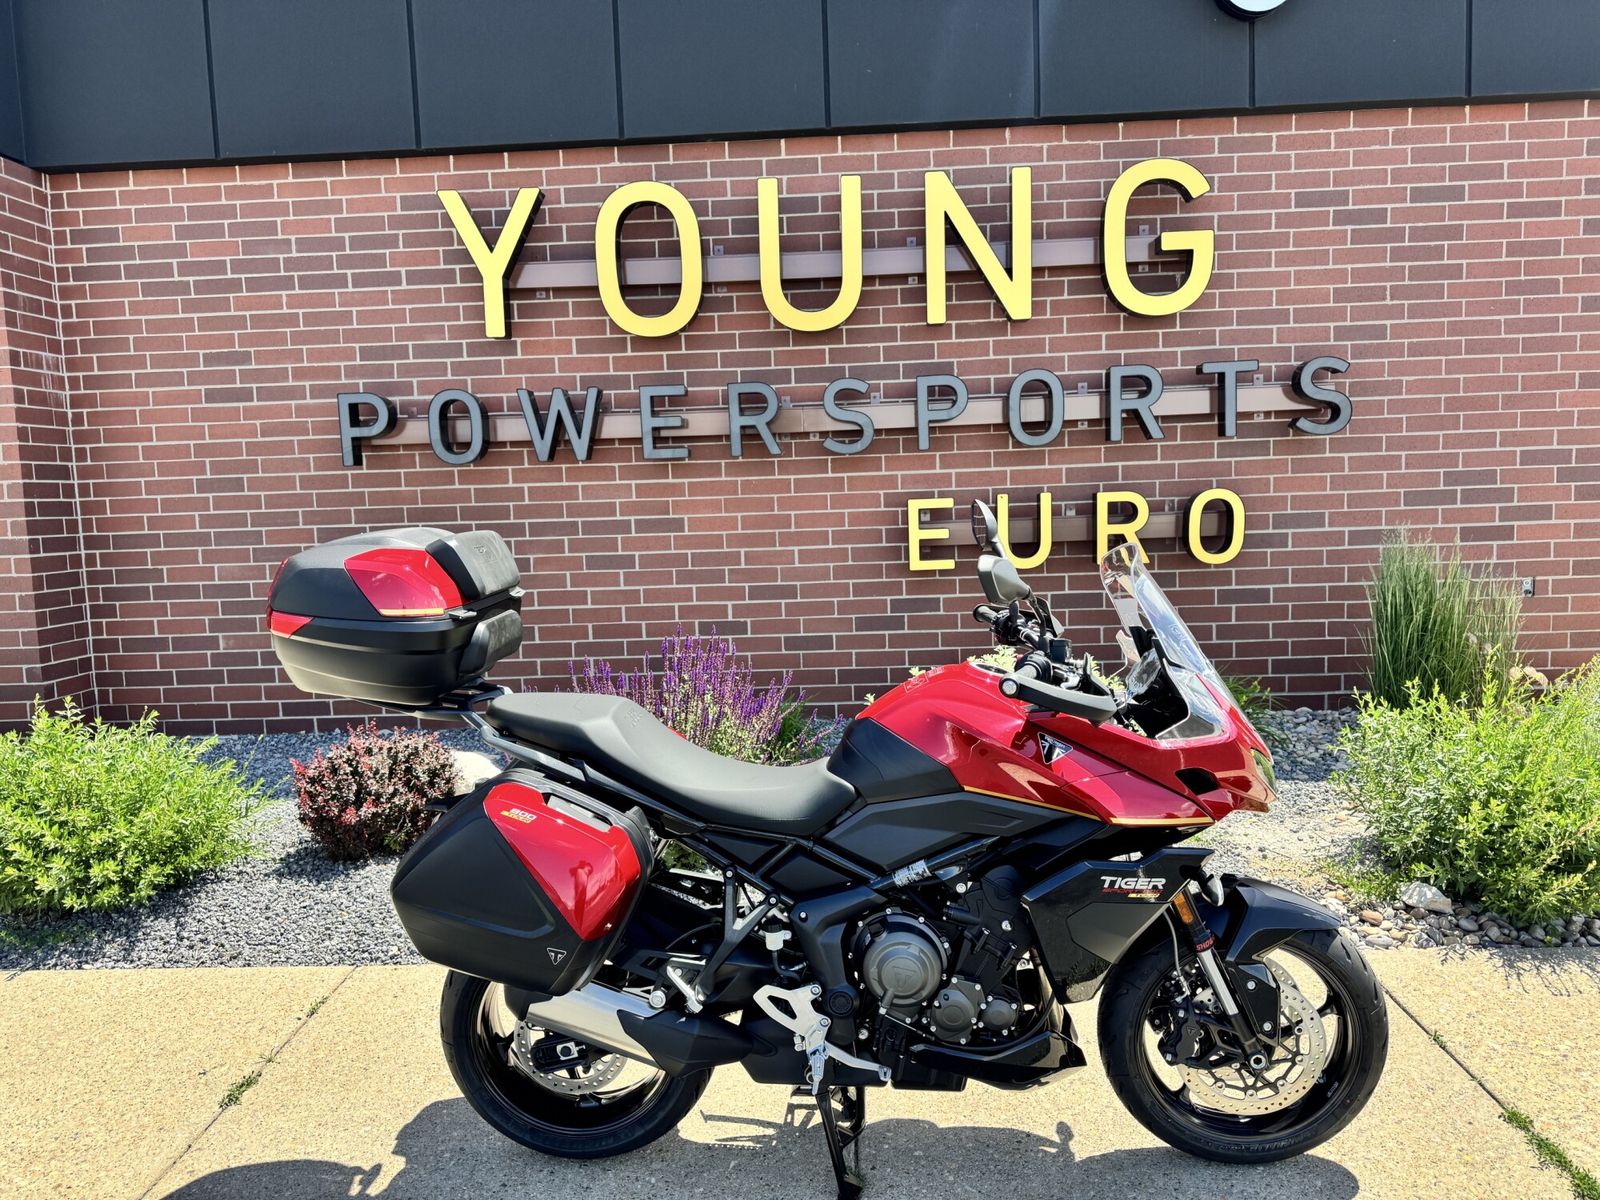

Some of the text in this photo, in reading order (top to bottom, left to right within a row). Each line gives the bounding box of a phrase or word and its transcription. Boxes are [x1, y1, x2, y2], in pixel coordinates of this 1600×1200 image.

[437, 157, 1216, 340] YOUNG
[337, 356, 1353, 468] POWERSPORTS
[907, 488, 1247, 571] EURO
[1100, 875, 1167, 890] TIGER
